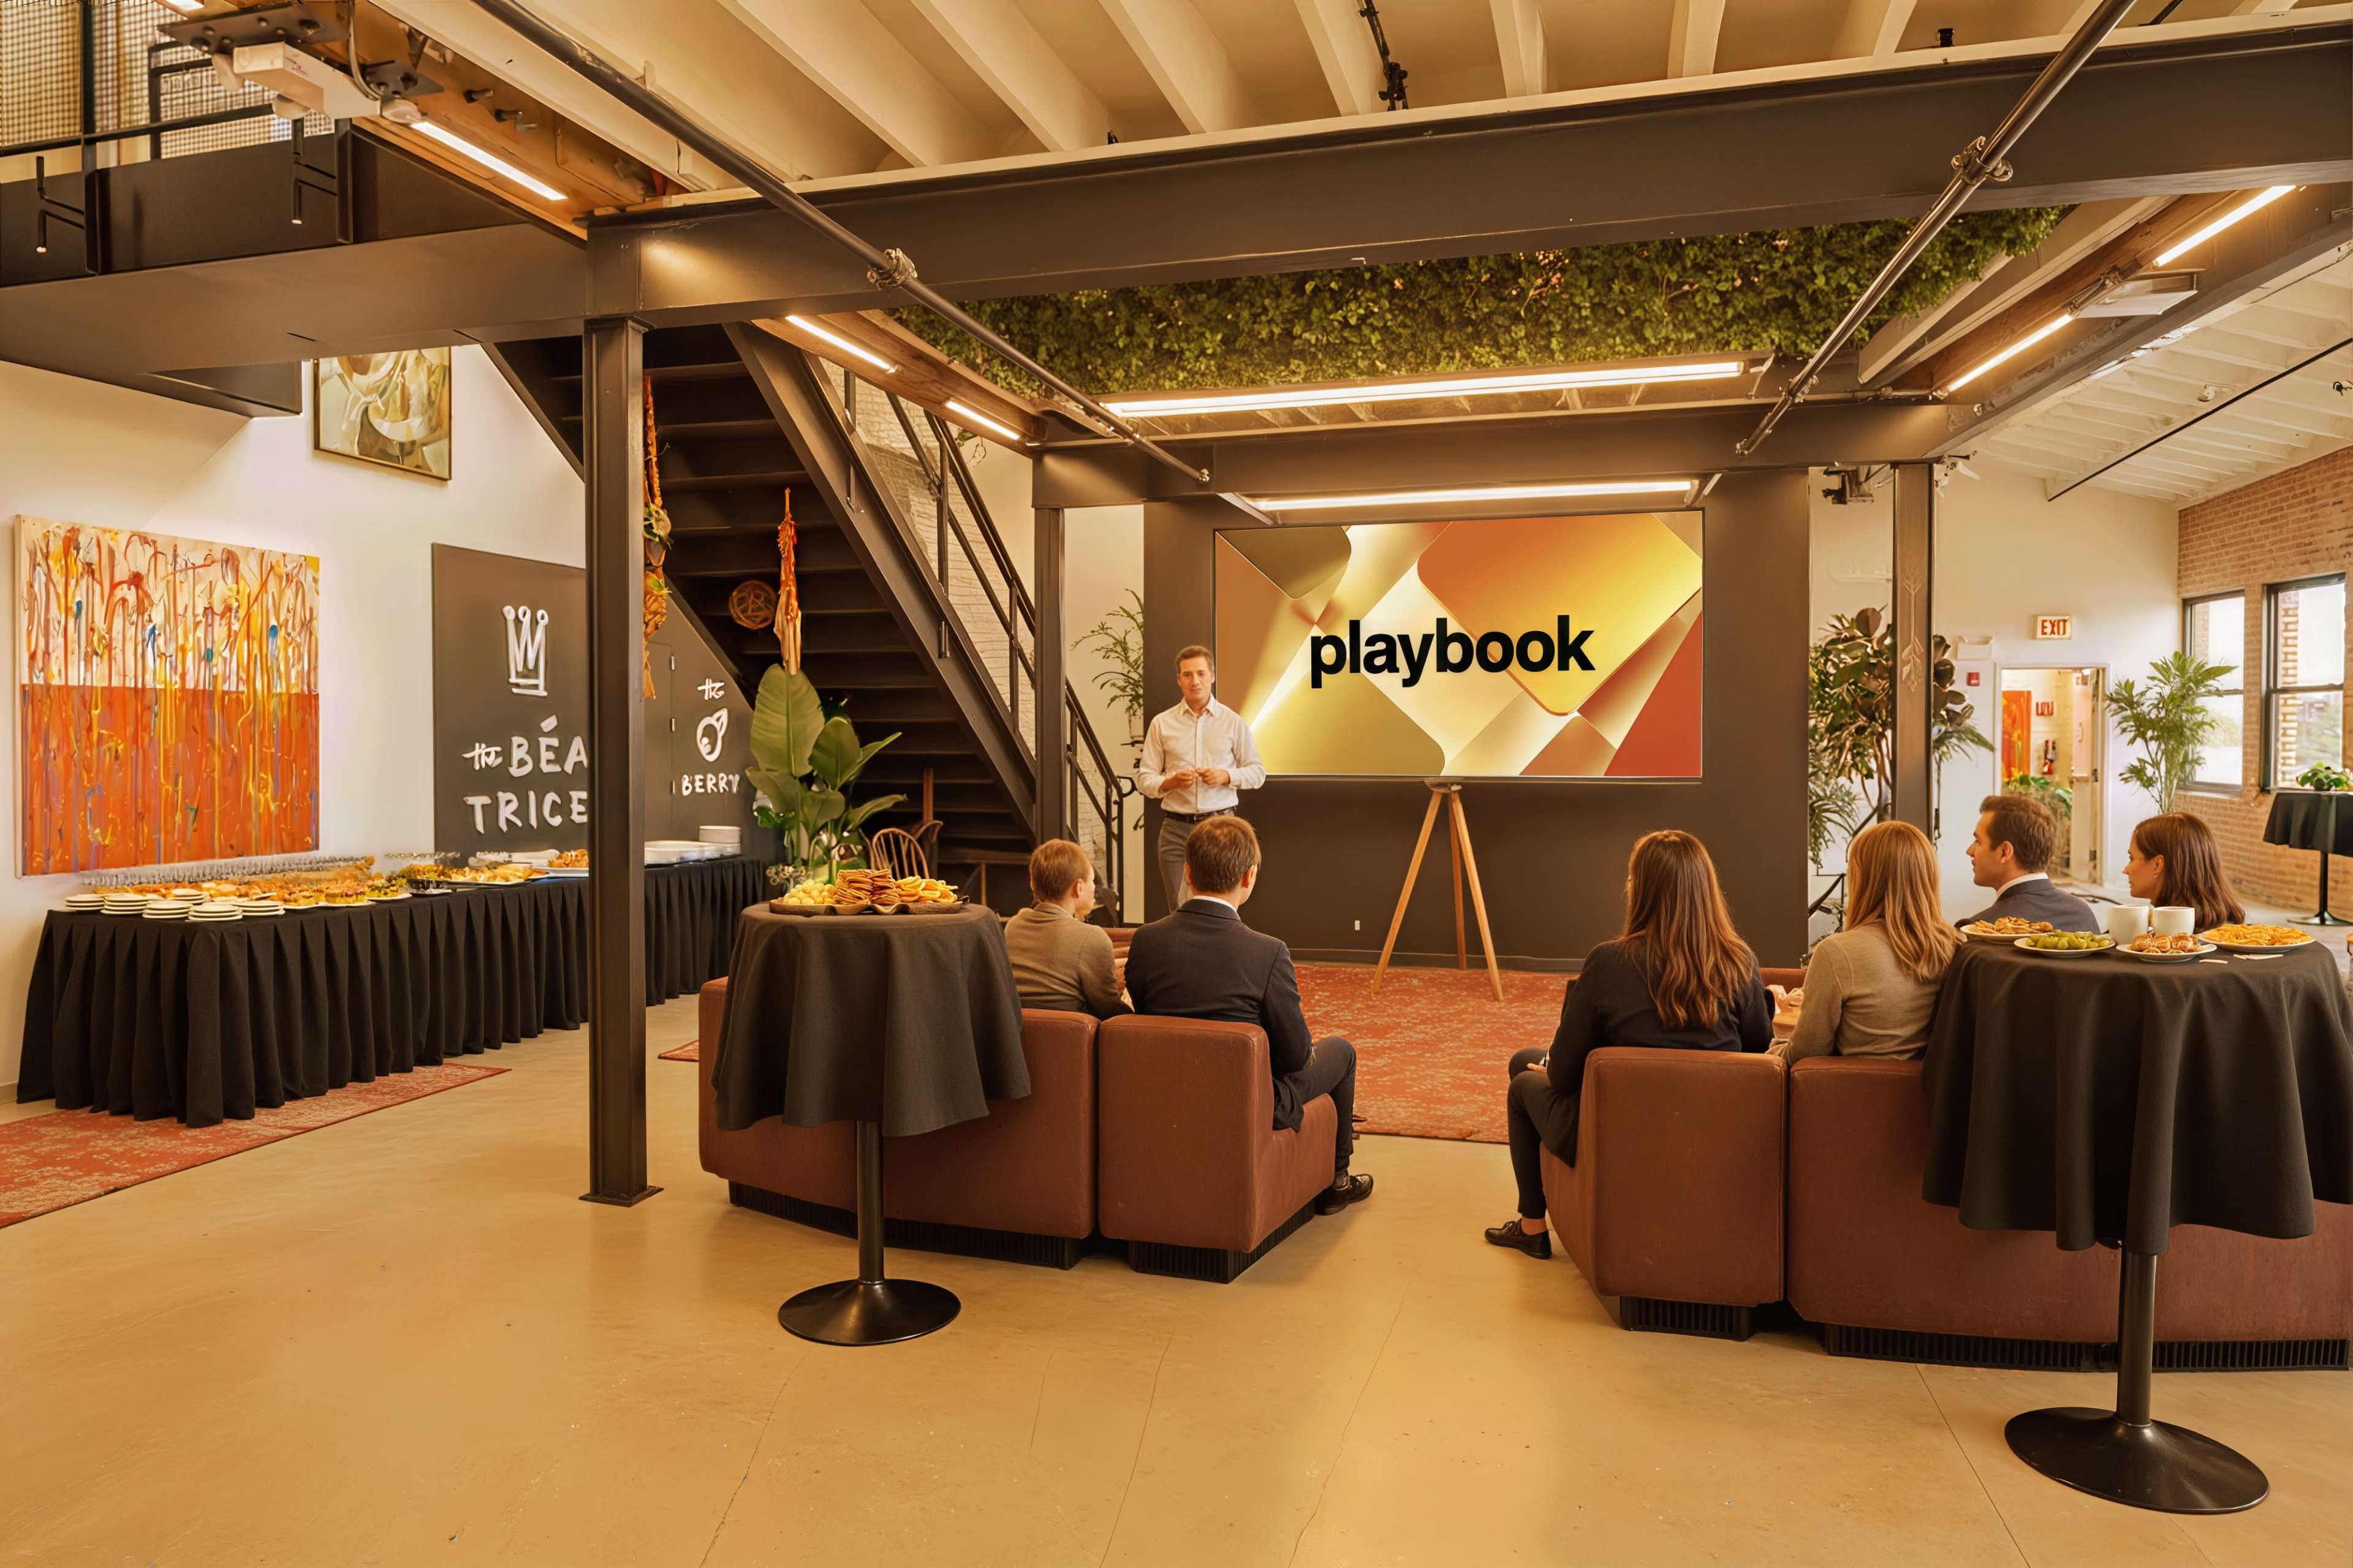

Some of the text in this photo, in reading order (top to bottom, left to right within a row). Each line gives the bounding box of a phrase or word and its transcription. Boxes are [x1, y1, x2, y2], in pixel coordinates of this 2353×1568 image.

[2041, 619, 2068, 635] EXIT
[1309, 615, 1596, 689] playbook
[507, 714, 588, 778] BÉA
[681, 773, 740, 797] BERRY
[463, 790, 588, 834] TRICE
